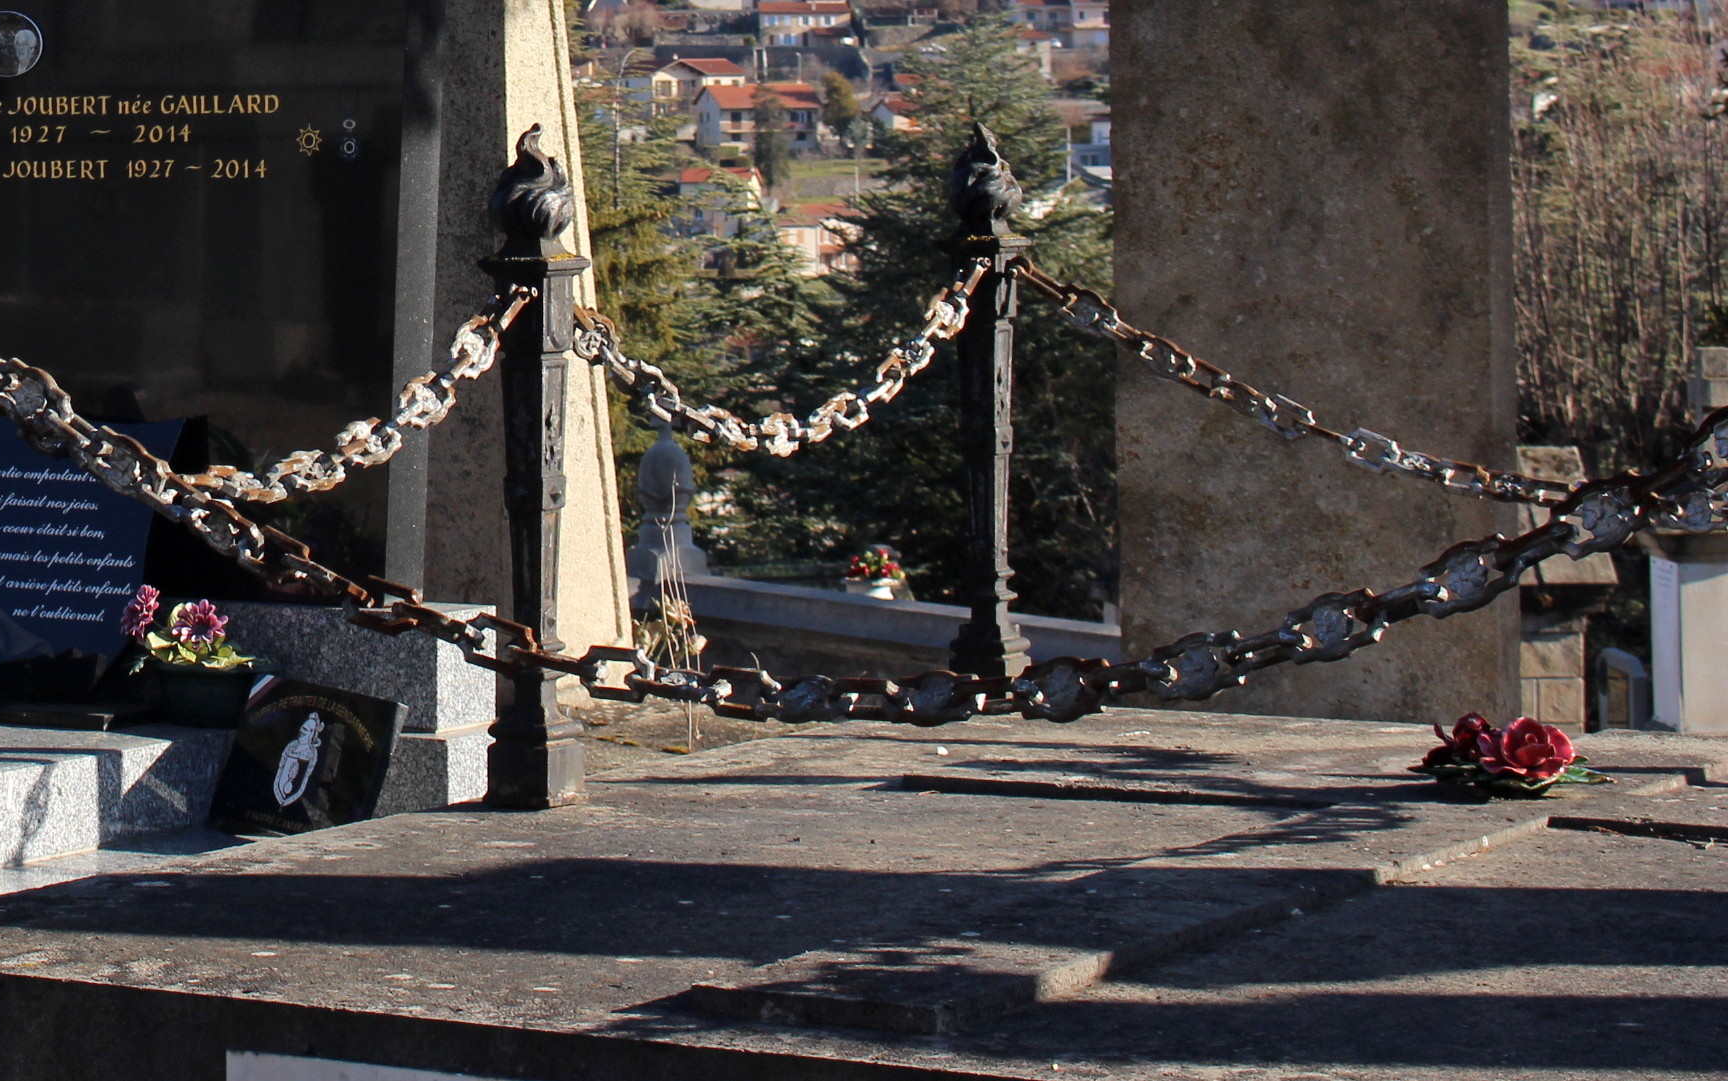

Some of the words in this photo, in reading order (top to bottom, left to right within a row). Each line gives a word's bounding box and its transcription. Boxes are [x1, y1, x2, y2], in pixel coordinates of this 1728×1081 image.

[7, 95, 110, 116] JOUBERT
[117, 94, 153, 115] née
[159, 94, 280, 115] GAILLARD
[9, 124, 67, 145] 1927
[132, 123, 192, 144] 2014
[2, 159, 108, 180] JOUBERT
[125, 159, 174, 179] 1927
[211, 158, 267, 179] 2014
[24, 468, 88, 484] emportant
[0, 493, 45, 513] faisait
[47, 500, 65, 509] nos
[64, 499, 98, 515] joies.
[2, 524, 35, 533] coeur
[36, 521, 65, 536] était
[67, 525, 79, 537] si
[81, 527, 105, 540] bon,
[46, 552, 86, 568] petits
[86, 554, 134, 571] enfants
[6, 579, 47, 590] arrière
[46, 579, 84, 596] petits
[84, 581, 132, 599] enfants
[13, 608, 29, 617] ne
[30, 604, 104, 622] l'oublieront.
